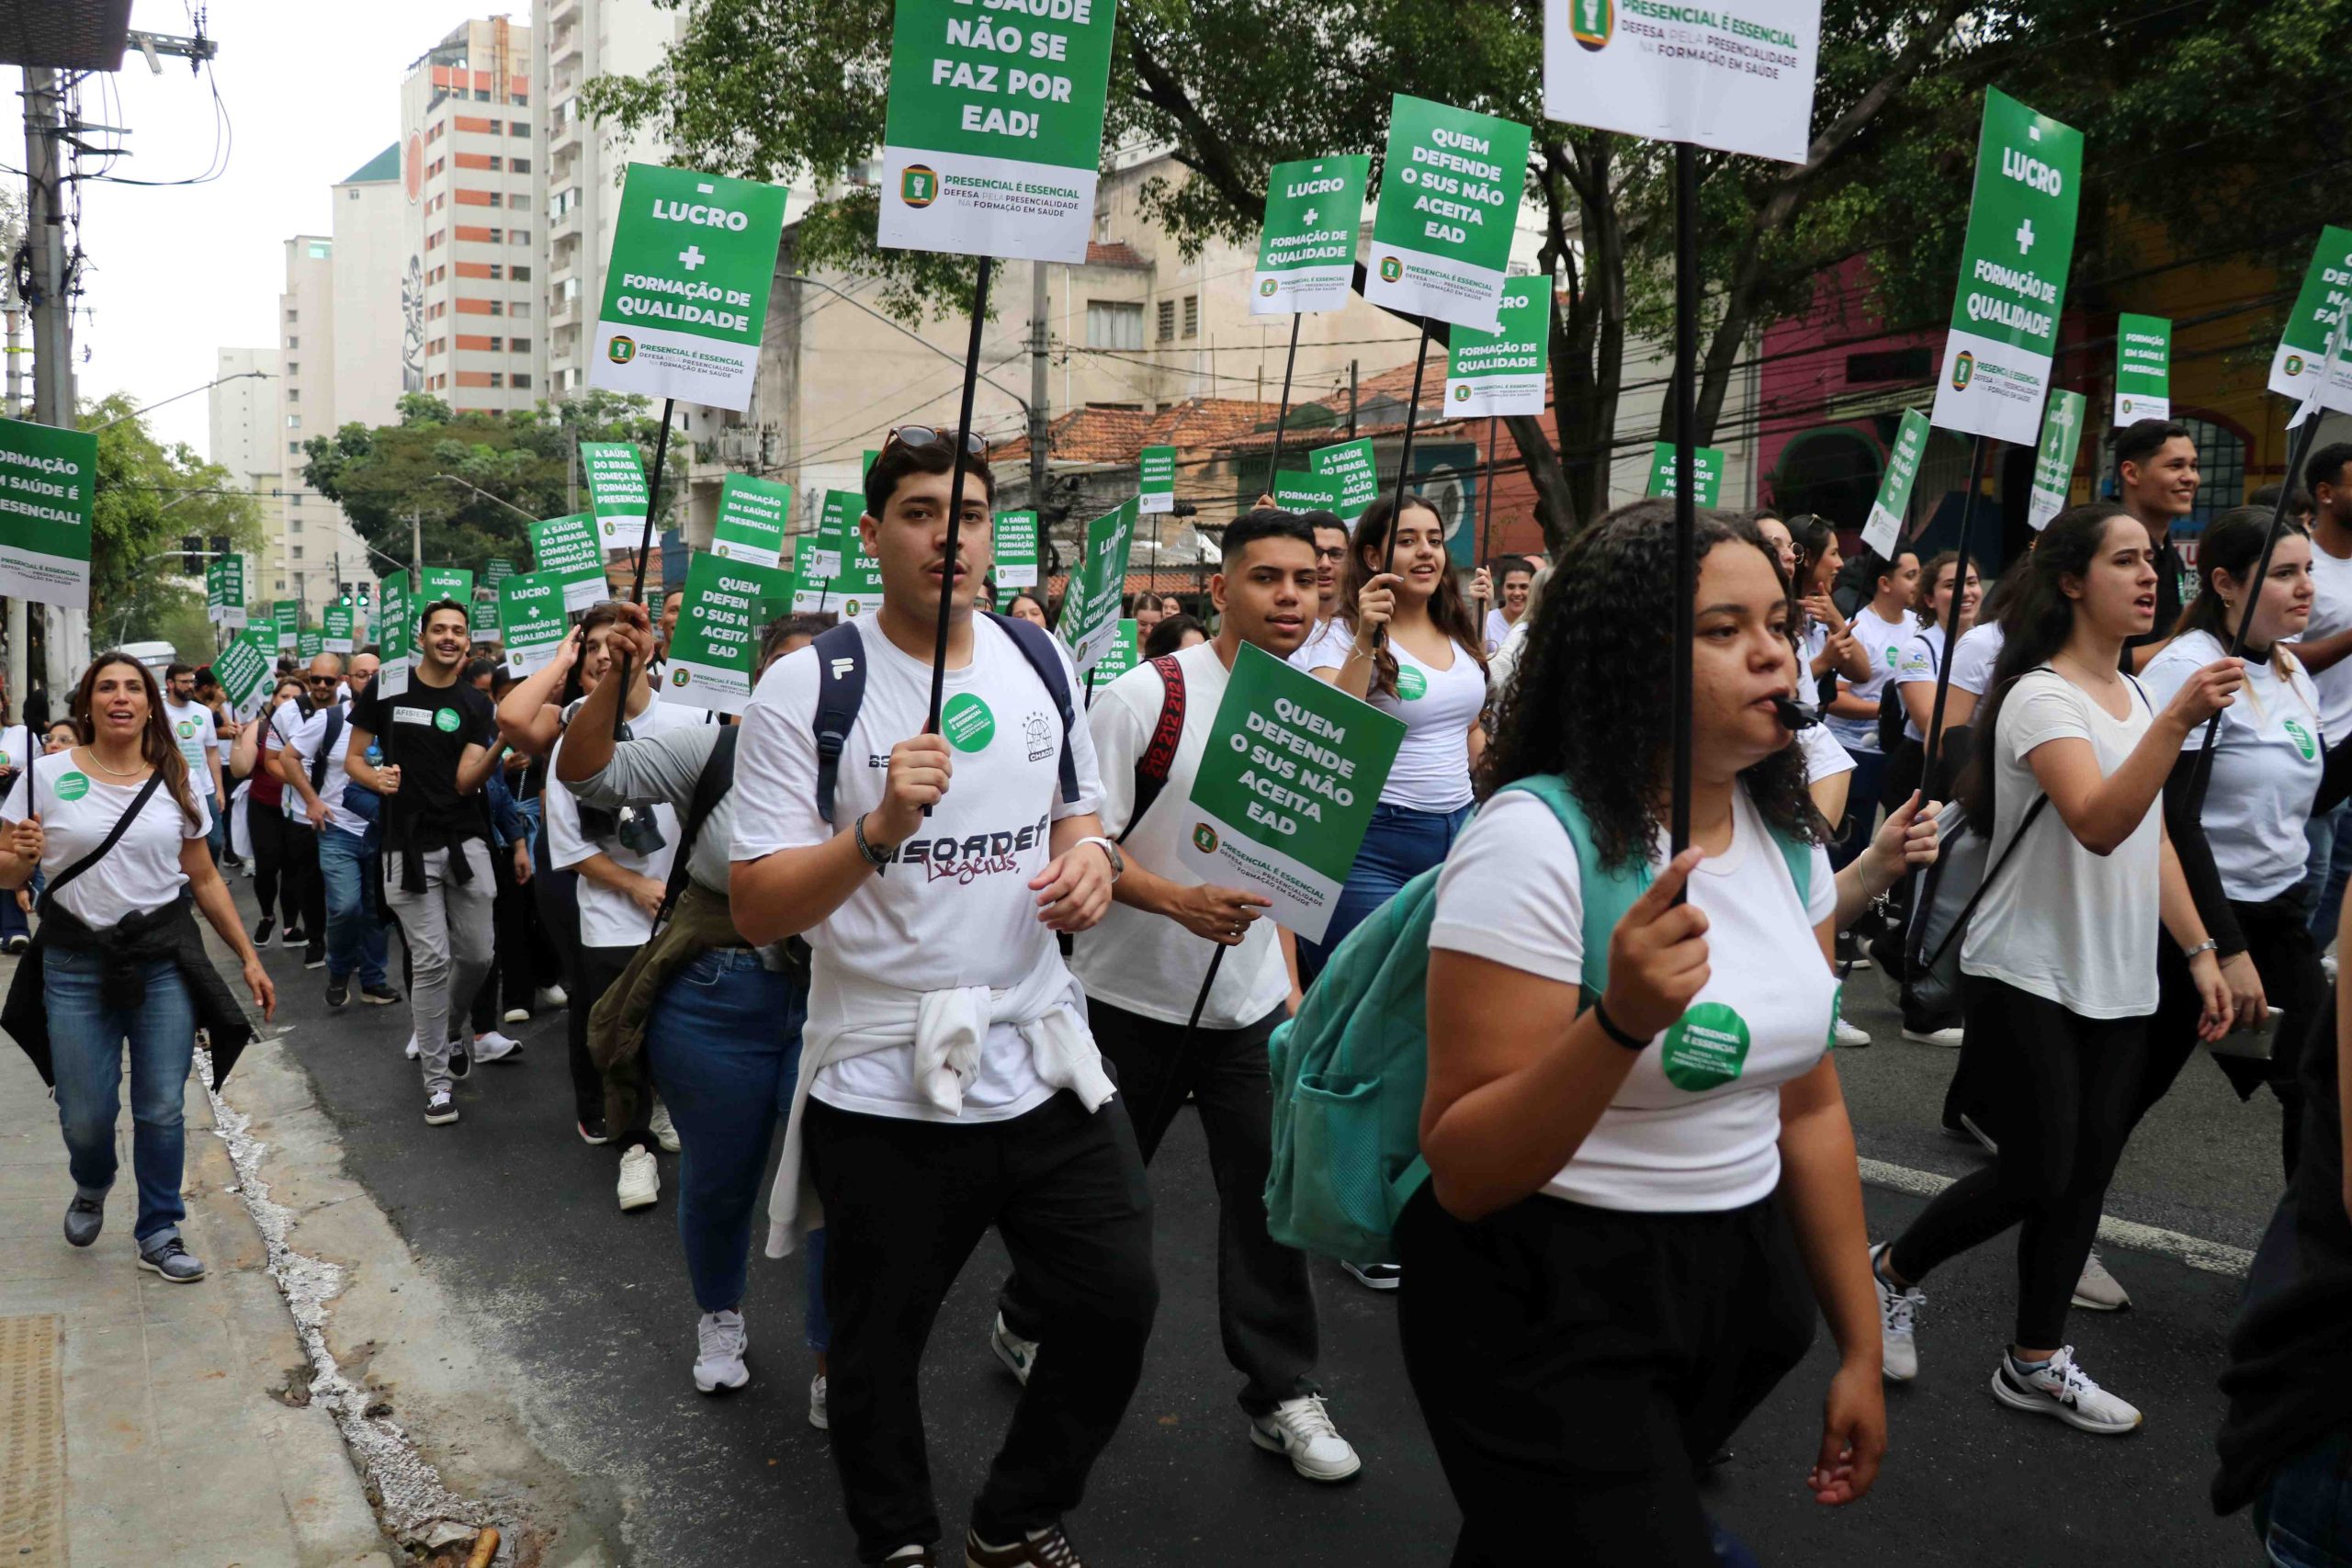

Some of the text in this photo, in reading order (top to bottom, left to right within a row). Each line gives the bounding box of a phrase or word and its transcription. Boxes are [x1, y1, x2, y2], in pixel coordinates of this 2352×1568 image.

[1622, 0, 1797, 49] PRESENCIAL É ESSENCIAL
[946, 15, 1068, 62] NÃO SE
[1623, 19, 1665, 39] DEFESA
[1707, 35, 1797, 68] PRESENCIALIDADE
[1657, 44, 1779, 80] FORMAÇÃO EM SAÚDE
[932, 58, 1072, 103] FAZ POR
[961, 104, 1040, 139] EAD!
[1431, 128, 1490, 156] QUEM
[1412, 146, 1502, 183] DEFENDE
[2002, 146, 2062, 197] LUCRO
[944, 175, 1080, 199] PRESENCIAL É ESSENCIAL
[1287, 176, 1344, 198] LUCRO
[1400, 167, 1505, 207] O SUS NÃO
[944, 188, 979, 199] DEFESA
[1005, 195, 1079, 210] PRESENCIALIDADE
[973, 200, 1065, 217] FORMAÇÃO EM SAÚDE
[652, 198, 748, 231] LUCRO
[1413, 195, 1484, 226] ACEITA
[1271, 230, 1348, 249] FORMAÇÃO DE
[1424, 220, 1467, 244] EAD
[1266, 246, 1347, 266] QUALIDADE
[1406, 273, 1492, 298] DEFESA PRESENCIALIDADE
[1407, 265, 1493, 291] PRESENCIAL ESSENCIAL
[1973, 259, 2057, 305] FORMAÇÃO DE
[622, 273, 752, 308] FORMAÇÃO DE
[1422, 283, 1453, 295] FORMAÇÃO
[616, 296, 750, 333] QUALIDADE
[1967, 292, 2052, 339] QUALIDADE
[640, 344, 744, 367] PRESENCIAL ESSENCIAL
[1459, 342, 1537, 356] FORMAÇÃO DE
[659, 361, 696, 372] FORMAÇÃO
[708, 369, 731, 378] SAÚDE
[683, 358, 744, 375] PRESENCIALIDADE
[1456, 357, 1538, 373] QUALIDADE
[0, 449, 79, 476] ORMAÇÃO
[604, 448, 631, 458] SAÚDE
[1323, 448, 1363, 465] A SAÚDE
[608, 461, 638, 470] BRASIL
[1336, 459, 1368, 473] BRASIL
[1359, 470, 1373, 479] NA
[594, 472, 642, 482] COMEÇA NA
[10, 477, 79, 501] SAÚDE É
[597, 482, 643, 493] FORMAÇÃO
[1278, 491, 1333, 503] FORMAÇÃO
[597, 495, 648, 504] PRESENCIAL
[731, 490, 781, 507] FORMAÇÃO
[1341, 492, 1376, 507] ENCIAL
[0, 499, 81, 525] ESENCIAL!
[728, 502, 780, 521] EM SAÚDE É
[1009, 515, 1030, 524] SAÚDE
[551, 521, 584, 534] SAÚDE
[723, 514, 779, 533] PRESENCIAL!
[540, 531, 591, 547] DO BRASIL
[999, 540, 1034, 548] FORMAÇÃO
[539, 540, 595, 558] COMEÇA NA
[542, 550, 595, 567] FORMAÇÃO
[544, 559, 600, 574] SENCIAL
[854, 558, 879, 569] FAZ
[431, 577, 462, 586] LUCRO
[718, 577, 762, 594] QUEM
[511, 586, 550, 600] LUCRO
[702, 590, 749, 610] DEFEN
[692, 606, 736, 625] O SUS
[509, 620, 550, 633] FORMAÇÃO
[510, 628, 562, 644] QUALIDADE
[700, 625, 749, 643] ACEITA
[225, 639, 245, 664] SAÚDE
[707, 643, 738, 658] EAD
[1111, 650, 1123, 659] SE
[221, 645, 252, 680] DO BRASIL
[224, 648, 257, 687] COMEÇA NA
[1105, 661, 1126, 670] POR
[230, 654, 260, 694] FORMAÇÃO
[1273, 697, 1346, 744] QUEM
[1246, 711, 1357, 779] DEFENDE
[1030, 749, 1054, 761] CHAOS
[1229, 733, 1353, 807] O SUS NÃO
[1238, 770, 1321, 823] ACEITA
[1246, 801, 1297, 836] EAD
[878, 813, 1049, 868] ISORDER
[1219, 849, 1323, 907] DEFESA PRESENCIALIDADE
[1222, 840, 1325, 900] PRESENCIAL ESSENCIAL
[1237, 866, 1310, 907] FORMAÇÃO EM SAÚDE
[1687, 1024, 1741, 1043] PRESENCIAL
[1690, 1037, 1737, 1054] ESSENCIAL
